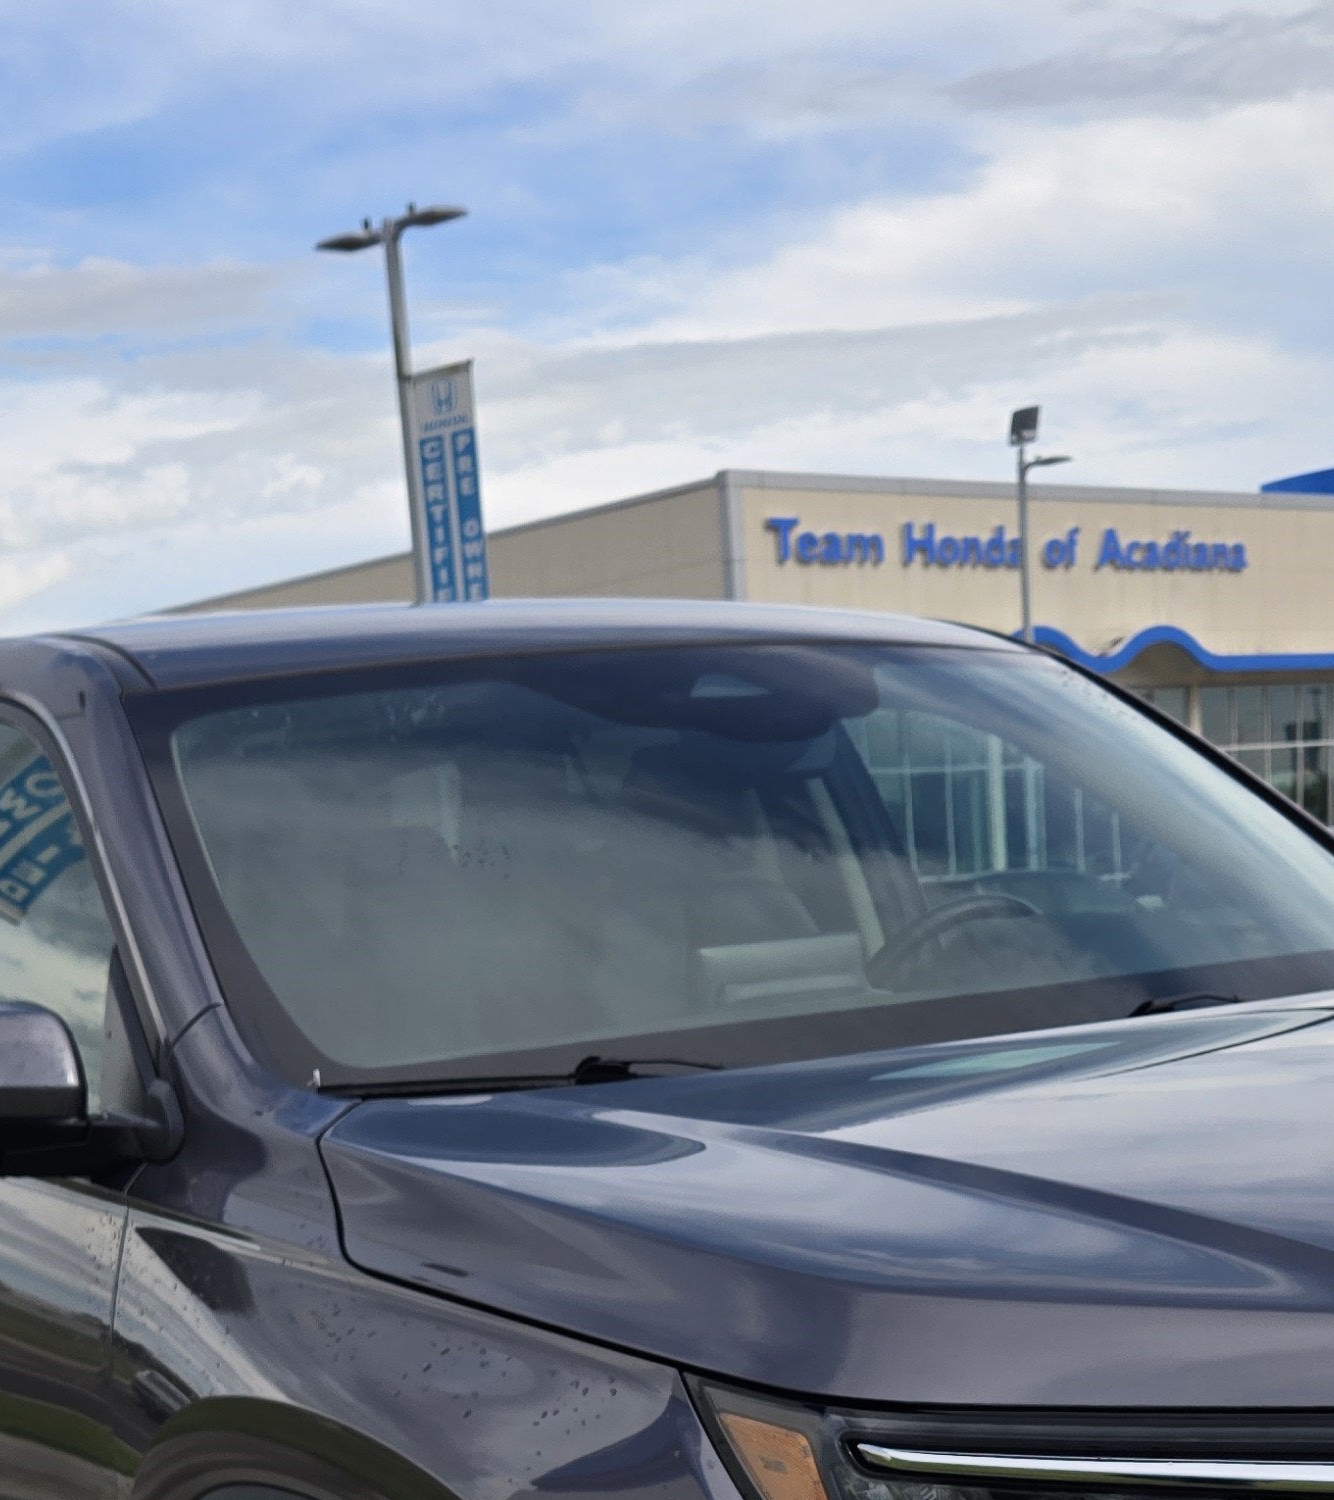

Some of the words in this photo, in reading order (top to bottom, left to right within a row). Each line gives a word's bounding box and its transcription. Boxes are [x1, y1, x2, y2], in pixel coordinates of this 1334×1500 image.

[765, 517, 884, 566] Team
[1042, 526, 1080, 570] of
[1094, 527, 1248, 572] Acadiana
